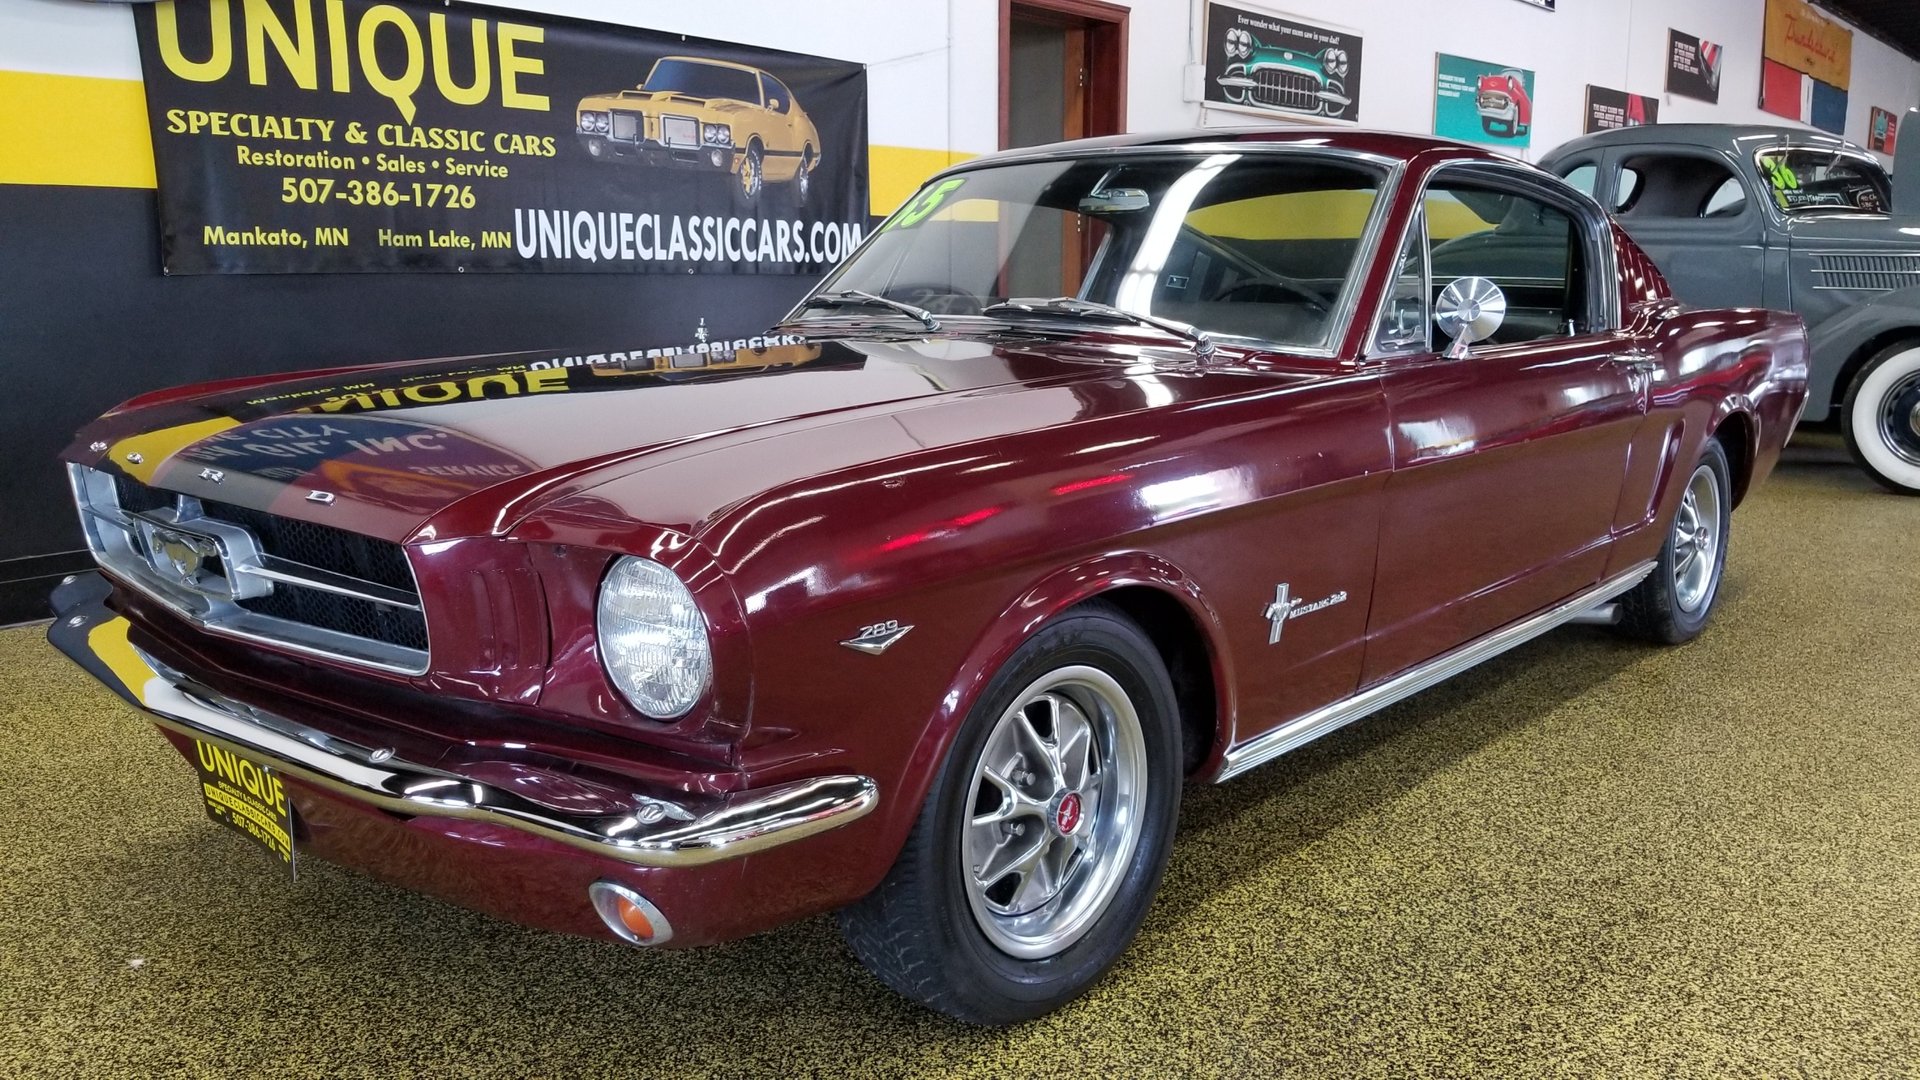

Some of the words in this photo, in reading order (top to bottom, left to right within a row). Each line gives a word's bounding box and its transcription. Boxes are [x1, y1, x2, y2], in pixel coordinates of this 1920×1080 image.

[1237, 14, 1250, 25] Ever
[1250, 19, 1268, 30] wonder
[1268, 22, 1280, 33] what
[1280, 26, 1292, 35] your
[1304, 31, 1313, 39] saw
[1318, 34, 1330, 43] your
[155, 0, 552, 126] UNIQUE
[166, 109, 335, 142] SPECIALTY
[345, 121, 368, 145] &
[377, 124, 486, 152] CLASSIC
[494, 132, 556, 157] CARS
[237, 145, 355, 170] Restoration
[376, 153, 426, 173] Sales
[445, 157, 509, 178] Service
[281, 177, 476, 209] 507-386-1726
[203, 226, 308, 248] Mankato,
[315, 228, 349, 246] MN
[378, 229, 423, 247] Ham
[429, 230, 475, 250] Lake,
[481, 231, 512, 249] MN
[514, 208, 862, 263] UNIQUECLASSICCARS.COM
[860, 620, 898, 638] 289
[196, 739, 287, 818] UNIQUE
